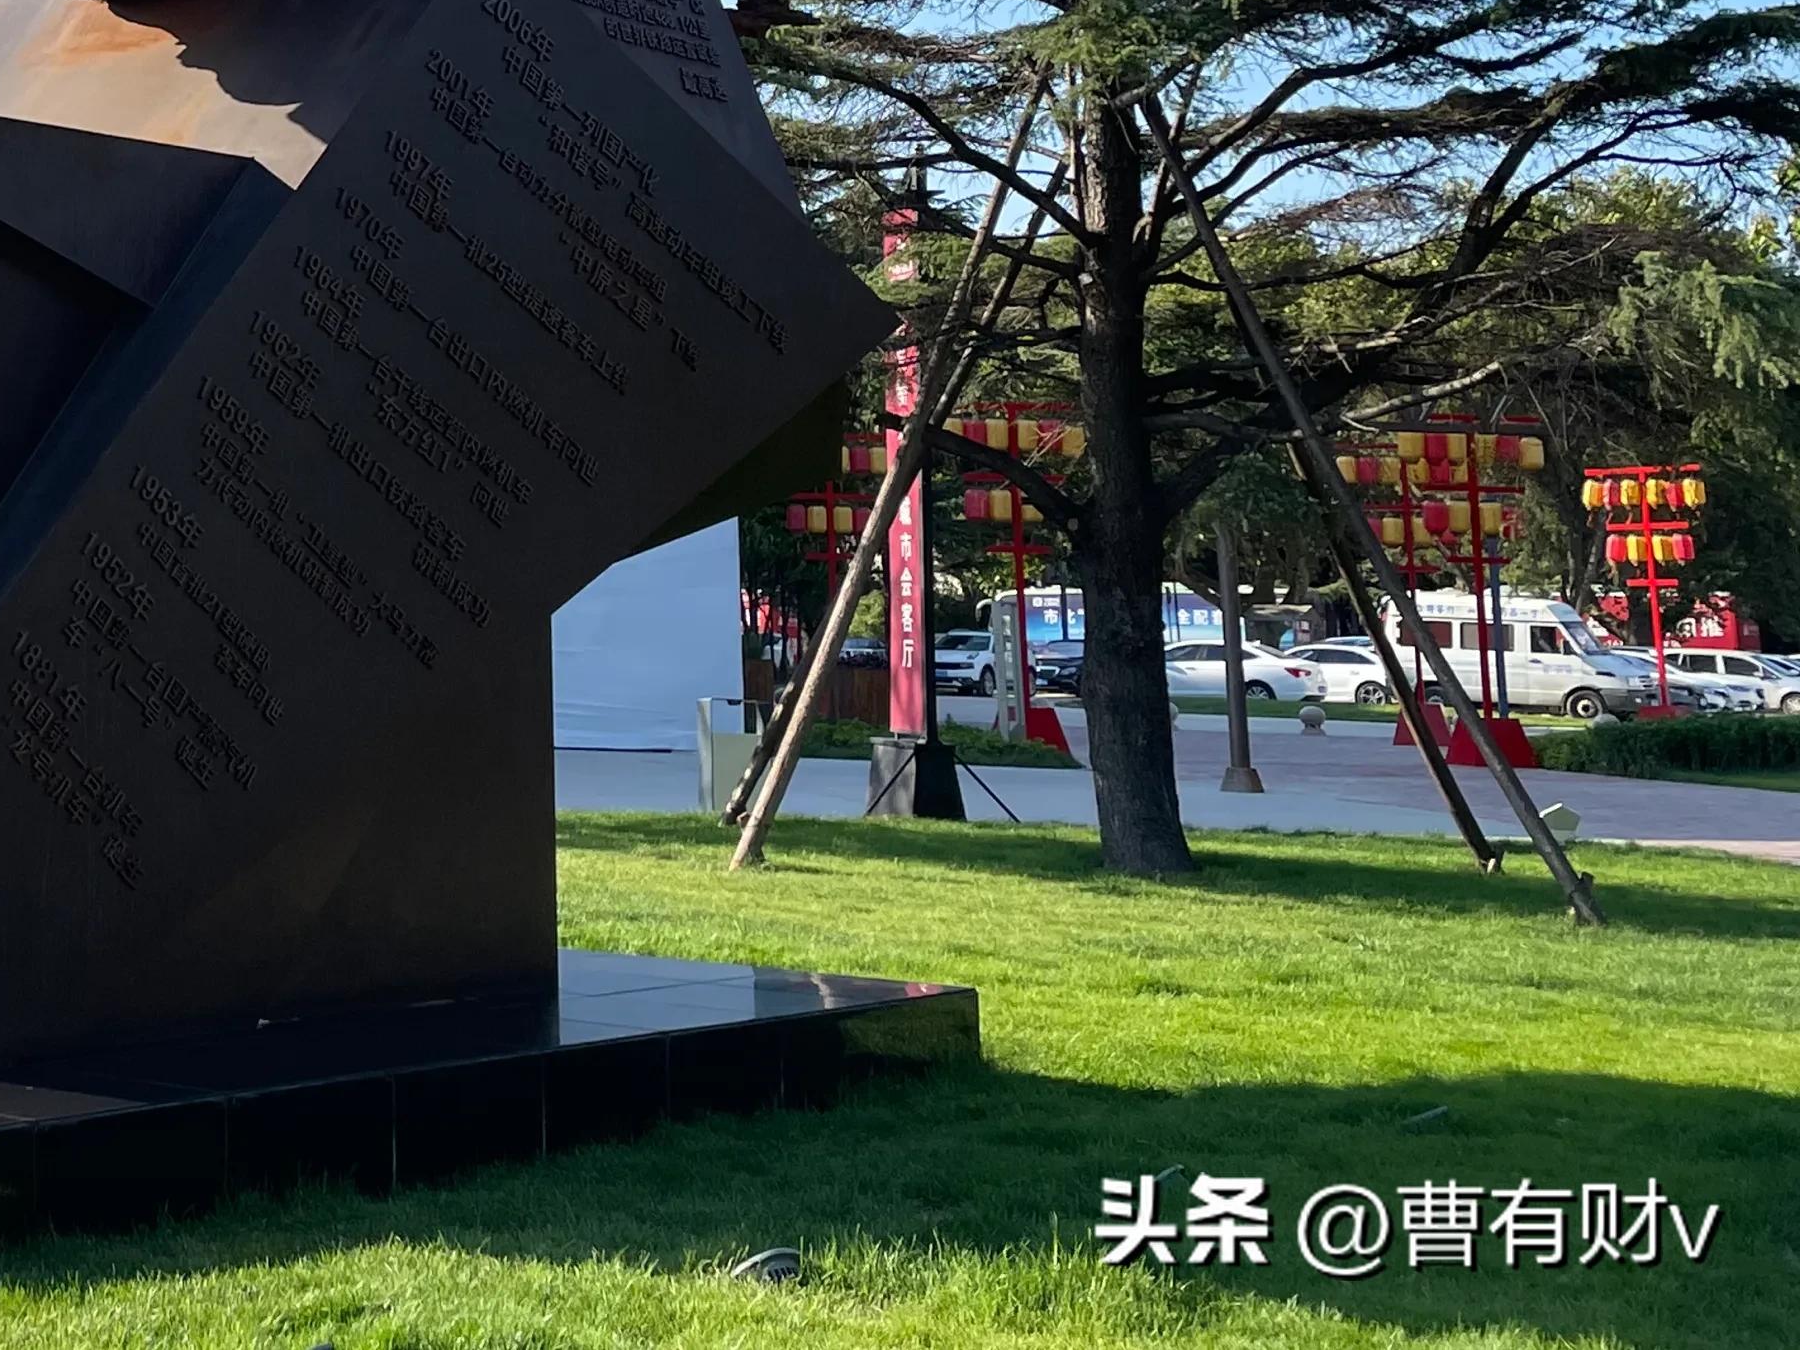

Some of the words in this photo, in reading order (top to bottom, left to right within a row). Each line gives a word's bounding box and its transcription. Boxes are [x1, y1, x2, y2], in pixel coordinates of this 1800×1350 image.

[425, 48, 495, 119] 2001年
[502, 46, 661, 197] 中国第一列国产化
[384, 130, 456, 202] 1997年
[333, 186, 410, 262] 1970年
[293, 245, 370, 320] 1964年
[247, 309, 323, 391] 1962年
[348, 241, 601, 488] 中国第一台出口内燃机车问世
[195, 375, 274, 458] 1959年
[301, 289, 536, 507] 中国第一台干线运营内燃机车
[247, 349, 465, 564] 中国第一批出口铁路客车
[129, 461, 207, 551] 1953年
[79, 528, 157, 622] 1952年
[410, 544, 494, 629] 研制成功
[12, 626, 90, 724] 1881年
[69, 576, 260, 792] 中国第一台国产蒸汽机
[212, 641, 286, 729] 客车问世
[7, 675, 145, 839] 中国第一台机车
